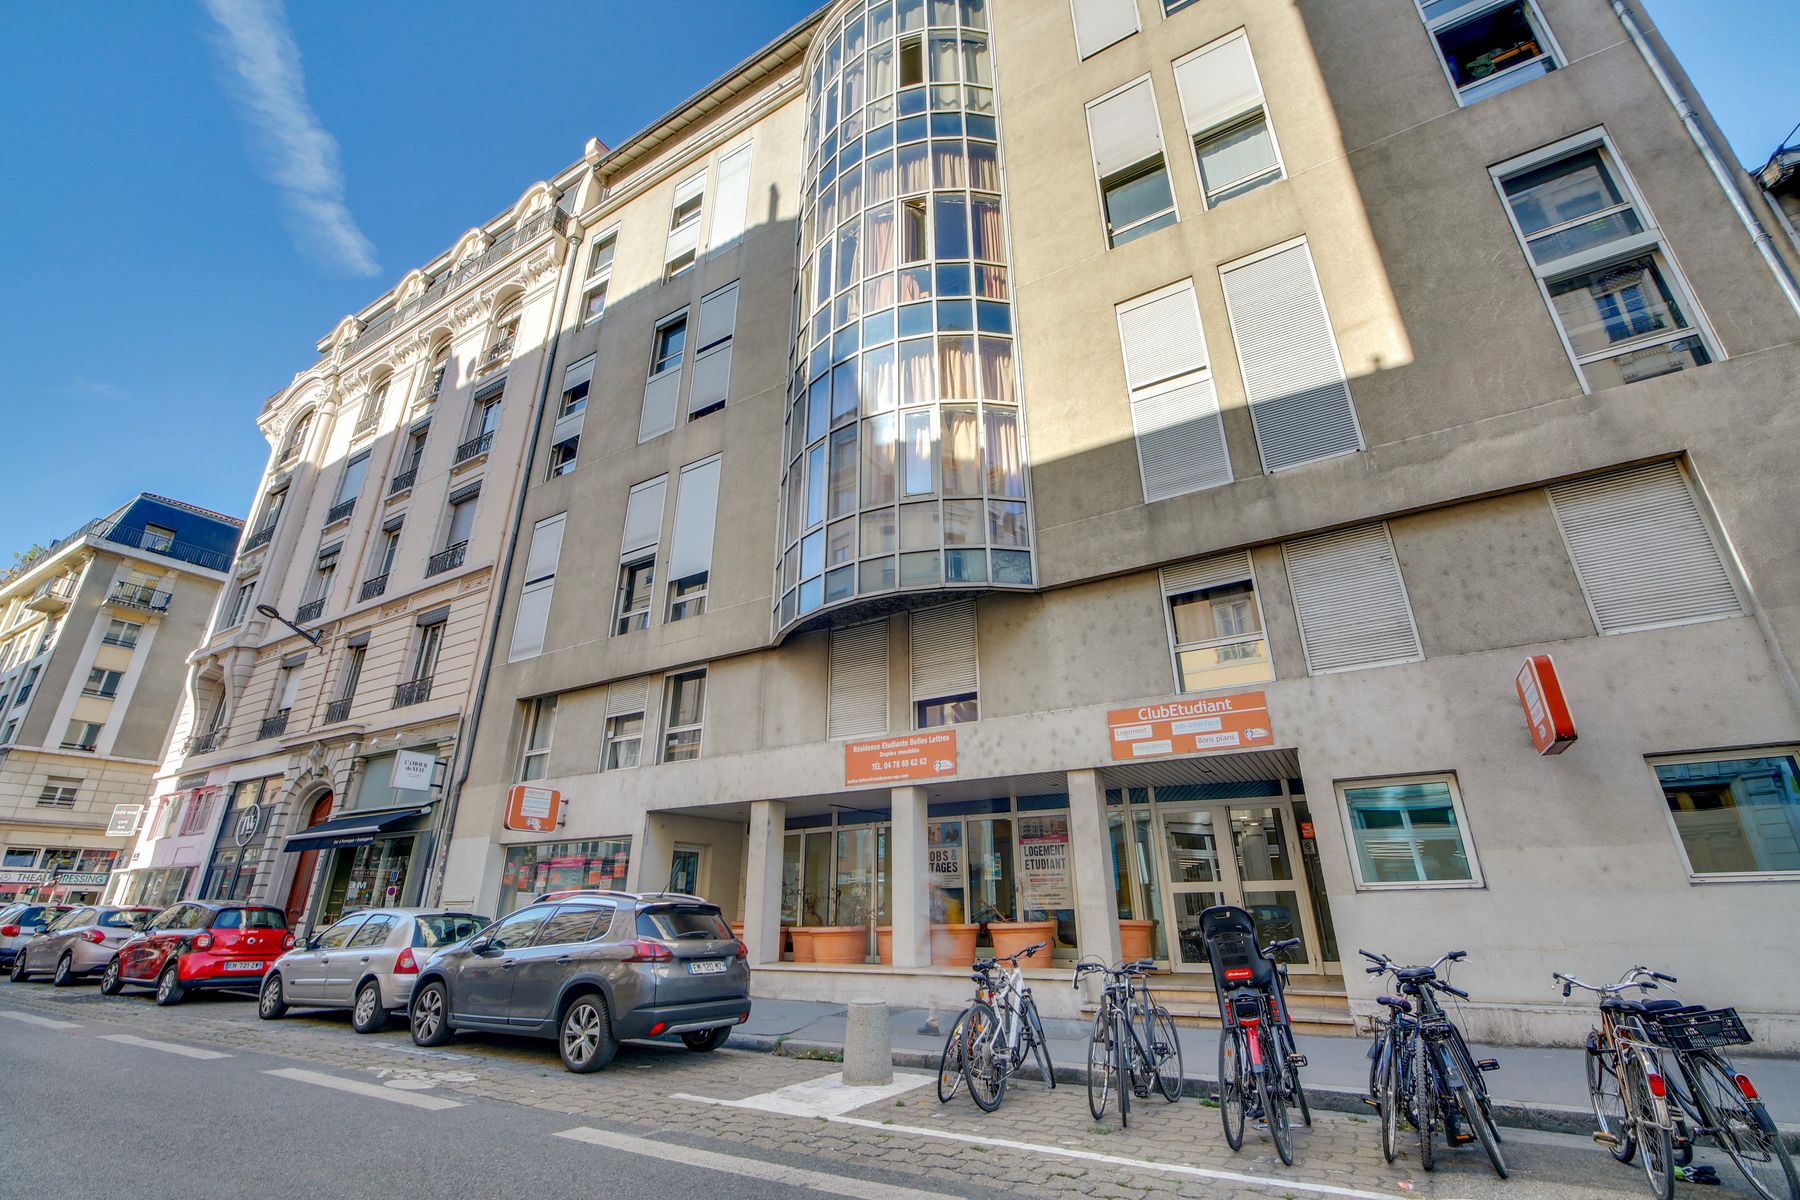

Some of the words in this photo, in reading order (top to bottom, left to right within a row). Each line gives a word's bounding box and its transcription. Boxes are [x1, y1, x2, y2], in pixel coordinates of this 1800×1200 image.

[1138, 699, 1232, 720] ClubEtudiant
[1116, 728, 1147, 738] Logement
[1197, 736, 1214, 744] Bons
[1215, 734, 1235, 744] plans
[853, 743, 880, 753] Résidence
[882, 740, 908, 750] Etudiante
[910, 737, 928, 746] Belles
[929, 734, 950, 744] Lettres
[884, 761, 891, 770] 04
[929, 850, 949, 862] OBS
[1024, 845, 1065, 857] LOGEMENT
[928, 861, 958, 873] TAGES
[1025, 858, 1066, 870] ETUDIANT
[60, 874, 104, 883] RESSING
